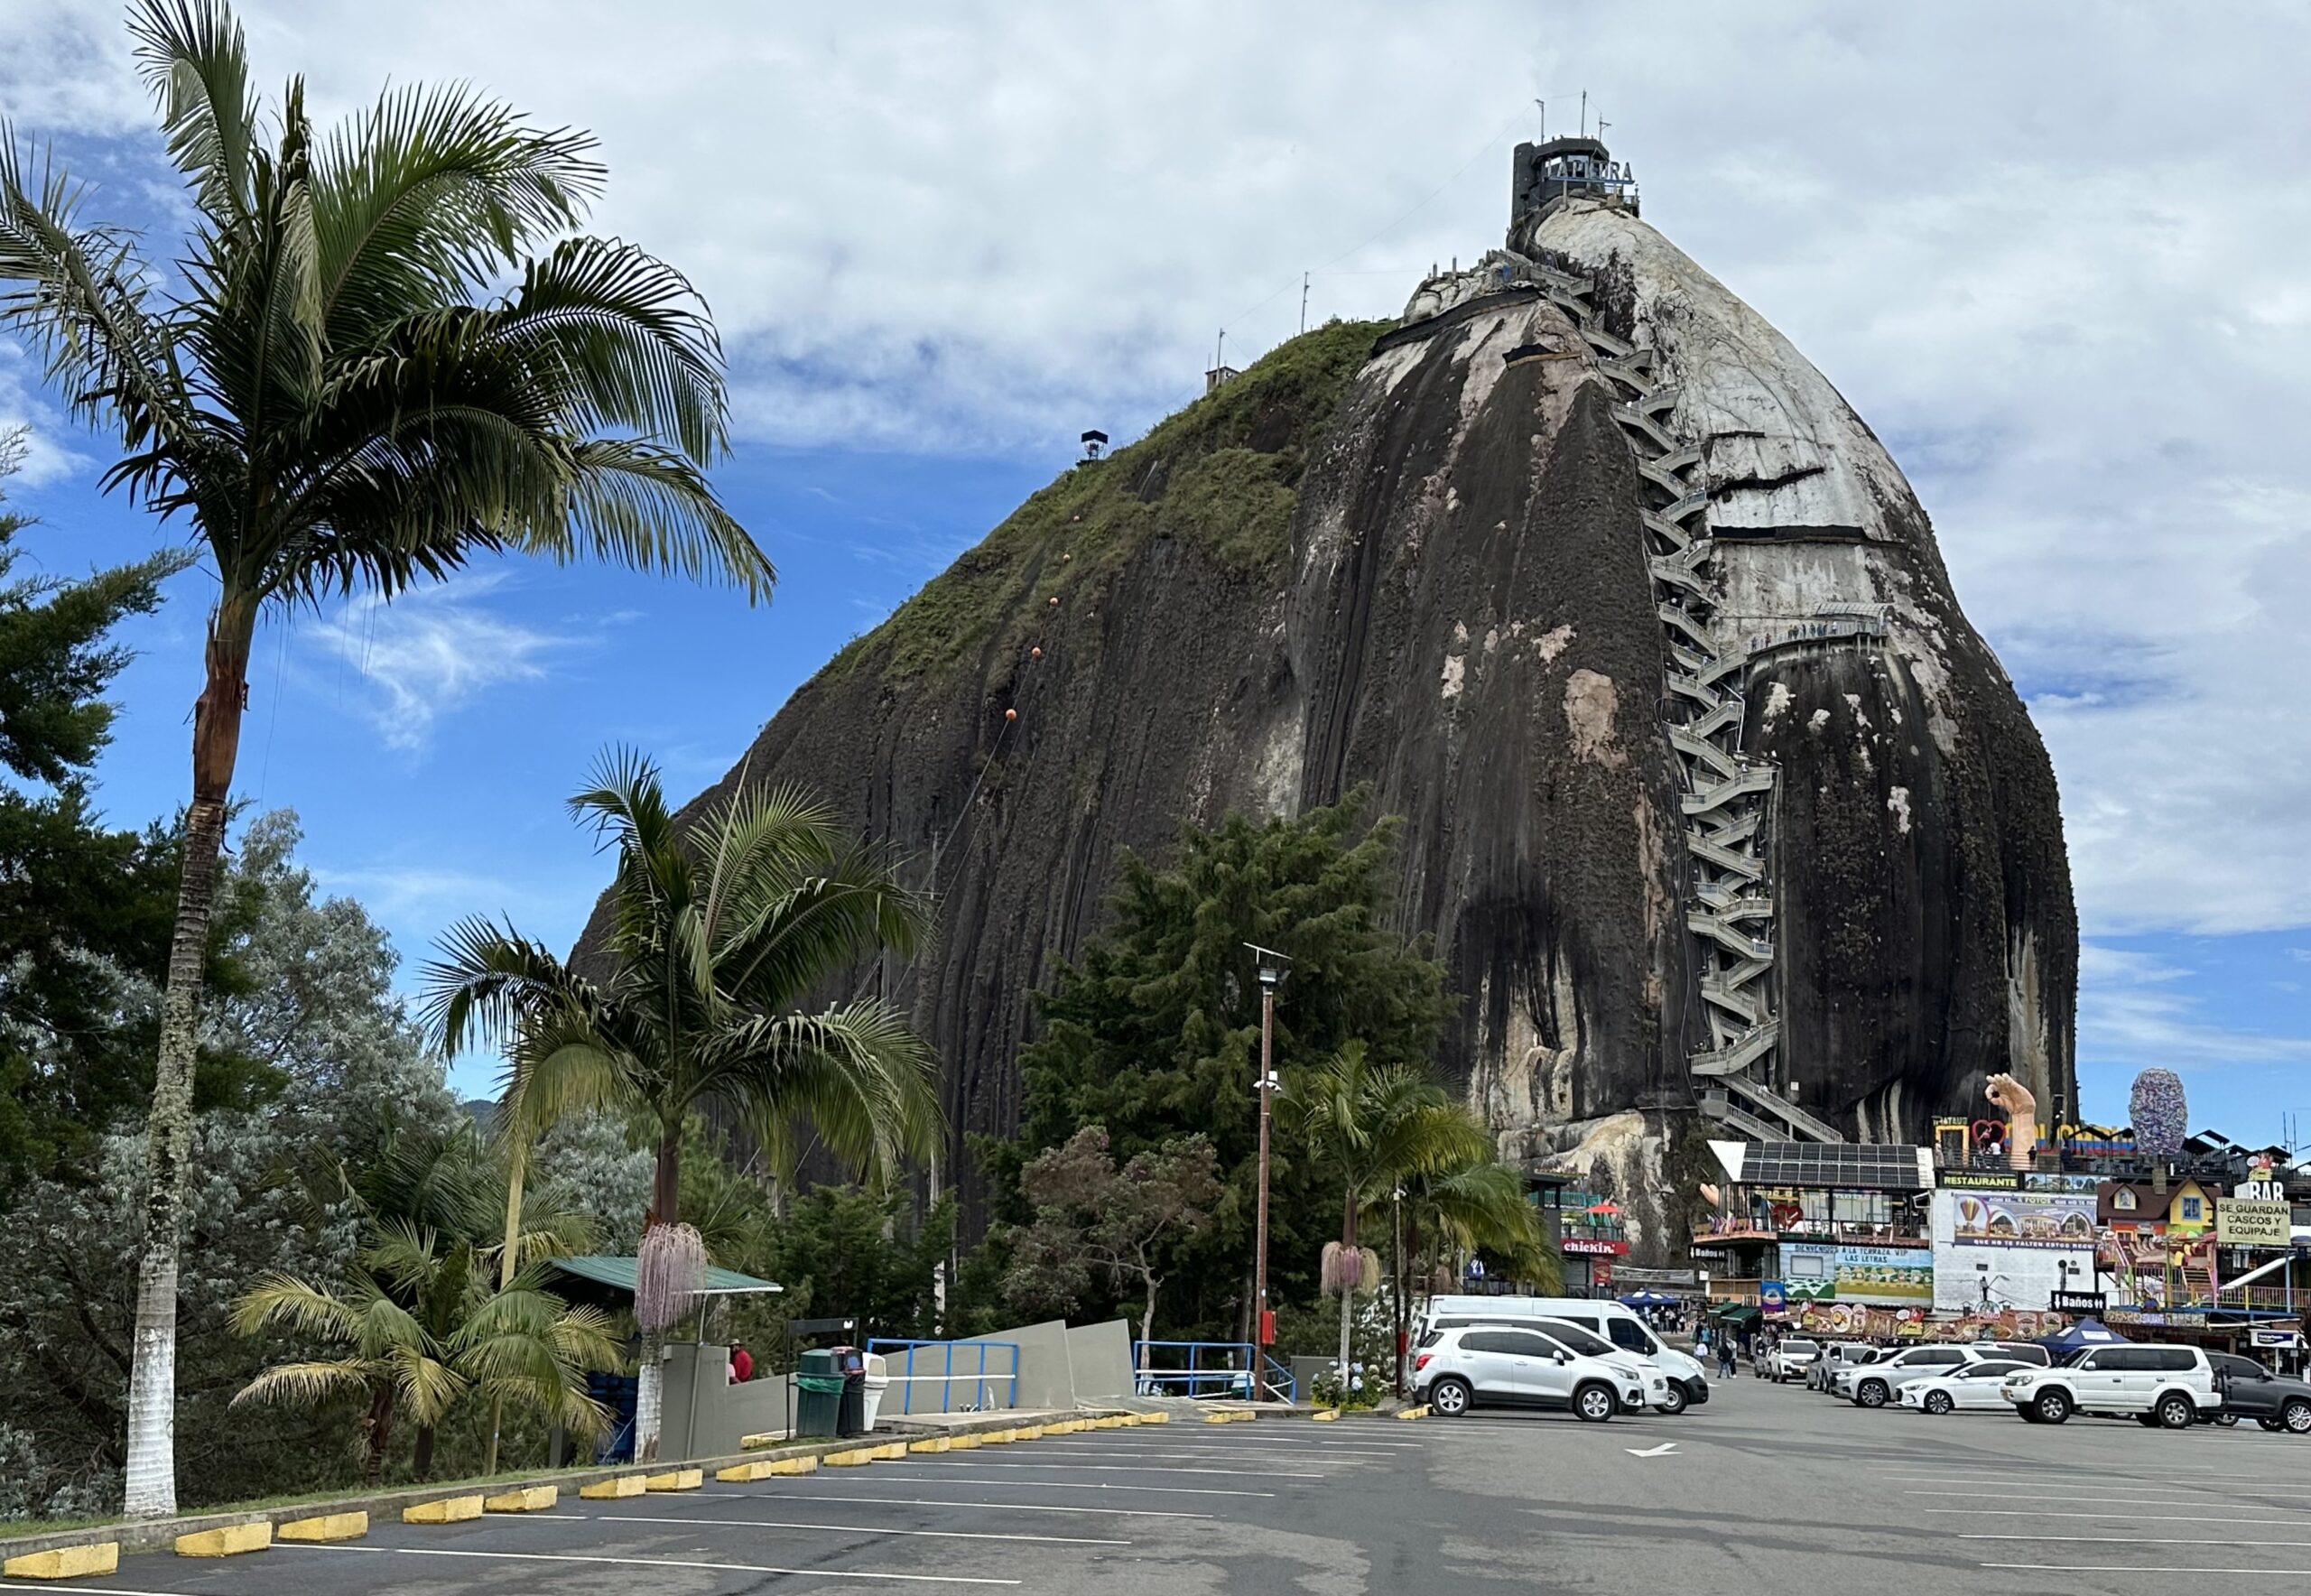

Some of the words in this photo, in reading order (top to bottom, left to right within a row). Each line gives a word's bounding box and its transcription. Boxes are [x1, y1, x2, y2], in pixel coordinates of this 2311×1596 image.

[1944, 1176, 2018, 1187] RESTAURANTE
[2249, 1182, 2284, 1201] BAR
[2219, 1203, 2233, 1212] SE
[2235, 1204, 2288, 1215] GUARDAN
[2227, 1215, 2271, 1225] CASCOS
[2275, 1217, 2282, 1225] Y
[2229, 1226, 2280, 1236] EQUIPAJE
[1795, 1244, 1839, 1254] BIENVENIDOS
[1860, 1248, 1891, 1256] TERRAZA
[1861, 1255, 1888, 1264] LETRAS
[2062, 1295, 2093, 1308] Baños
